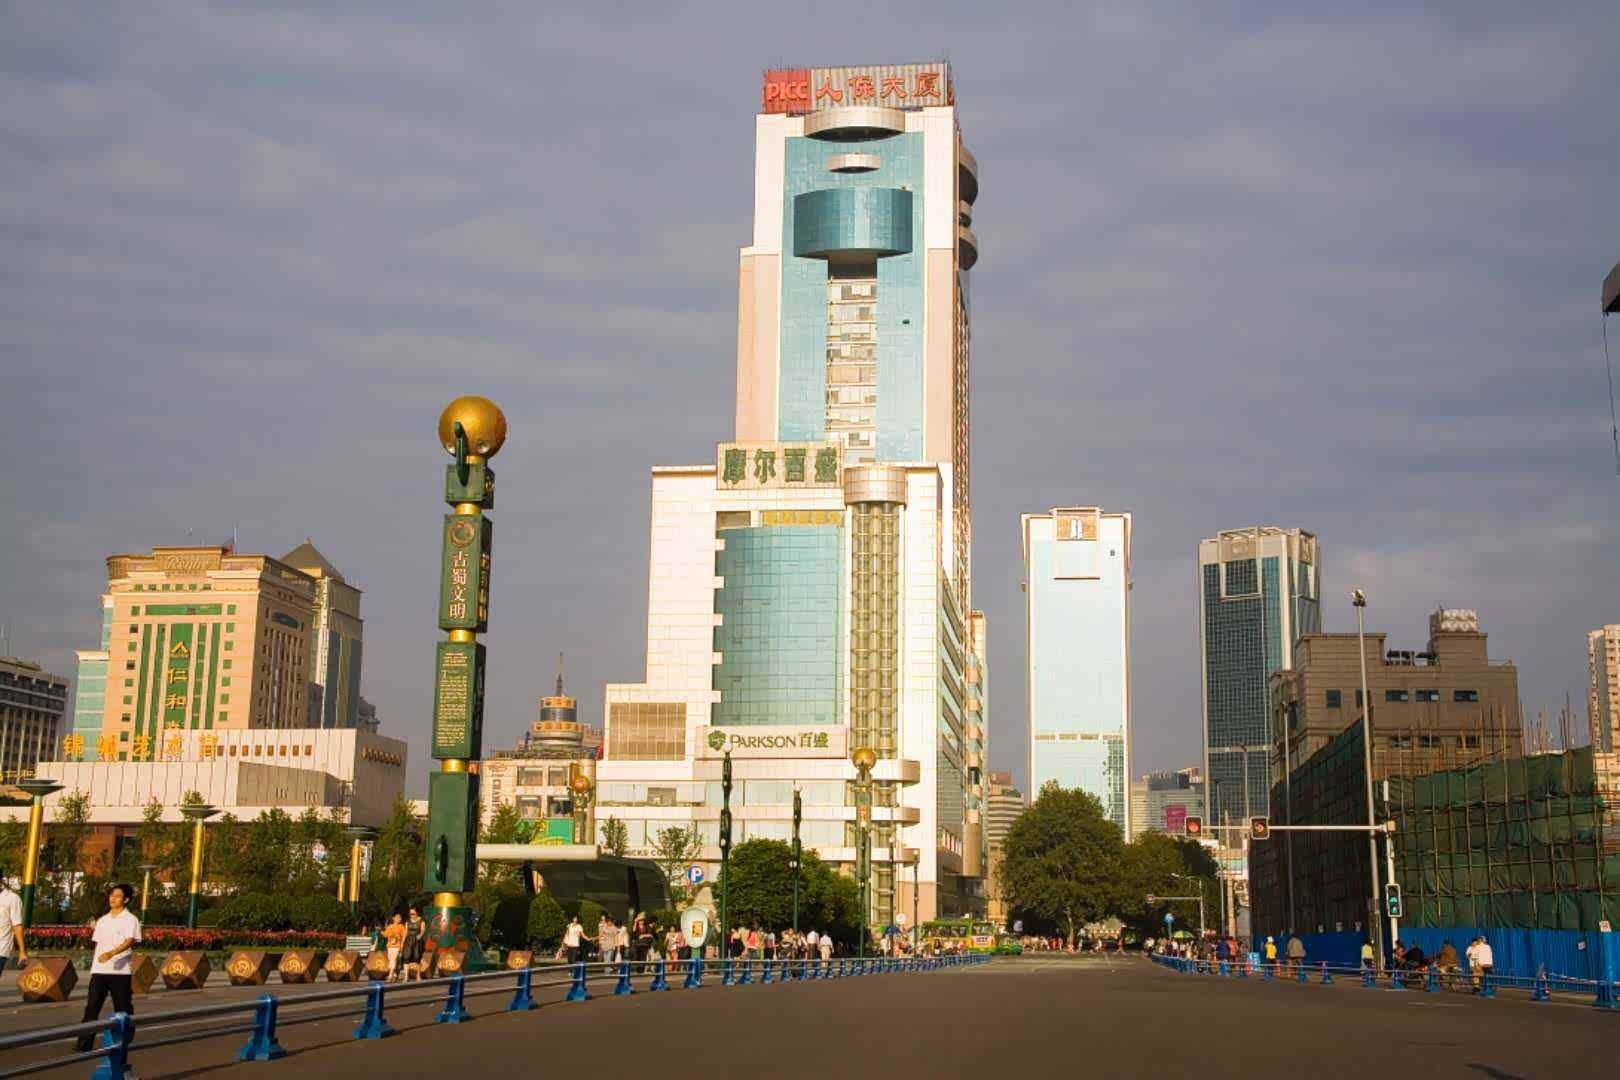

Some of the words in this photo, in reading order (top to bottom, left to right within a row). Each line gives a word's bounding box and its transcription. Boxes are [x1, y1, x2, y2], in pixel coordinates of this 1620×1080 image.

[766, 79, 809, 101] PICC
[815, 72, 941, 102] 人保大厦
[730, 734, 797, 749] PARKSON
[799, 732, 829, 749] 百盛
[690, 867, 703, 882] P
